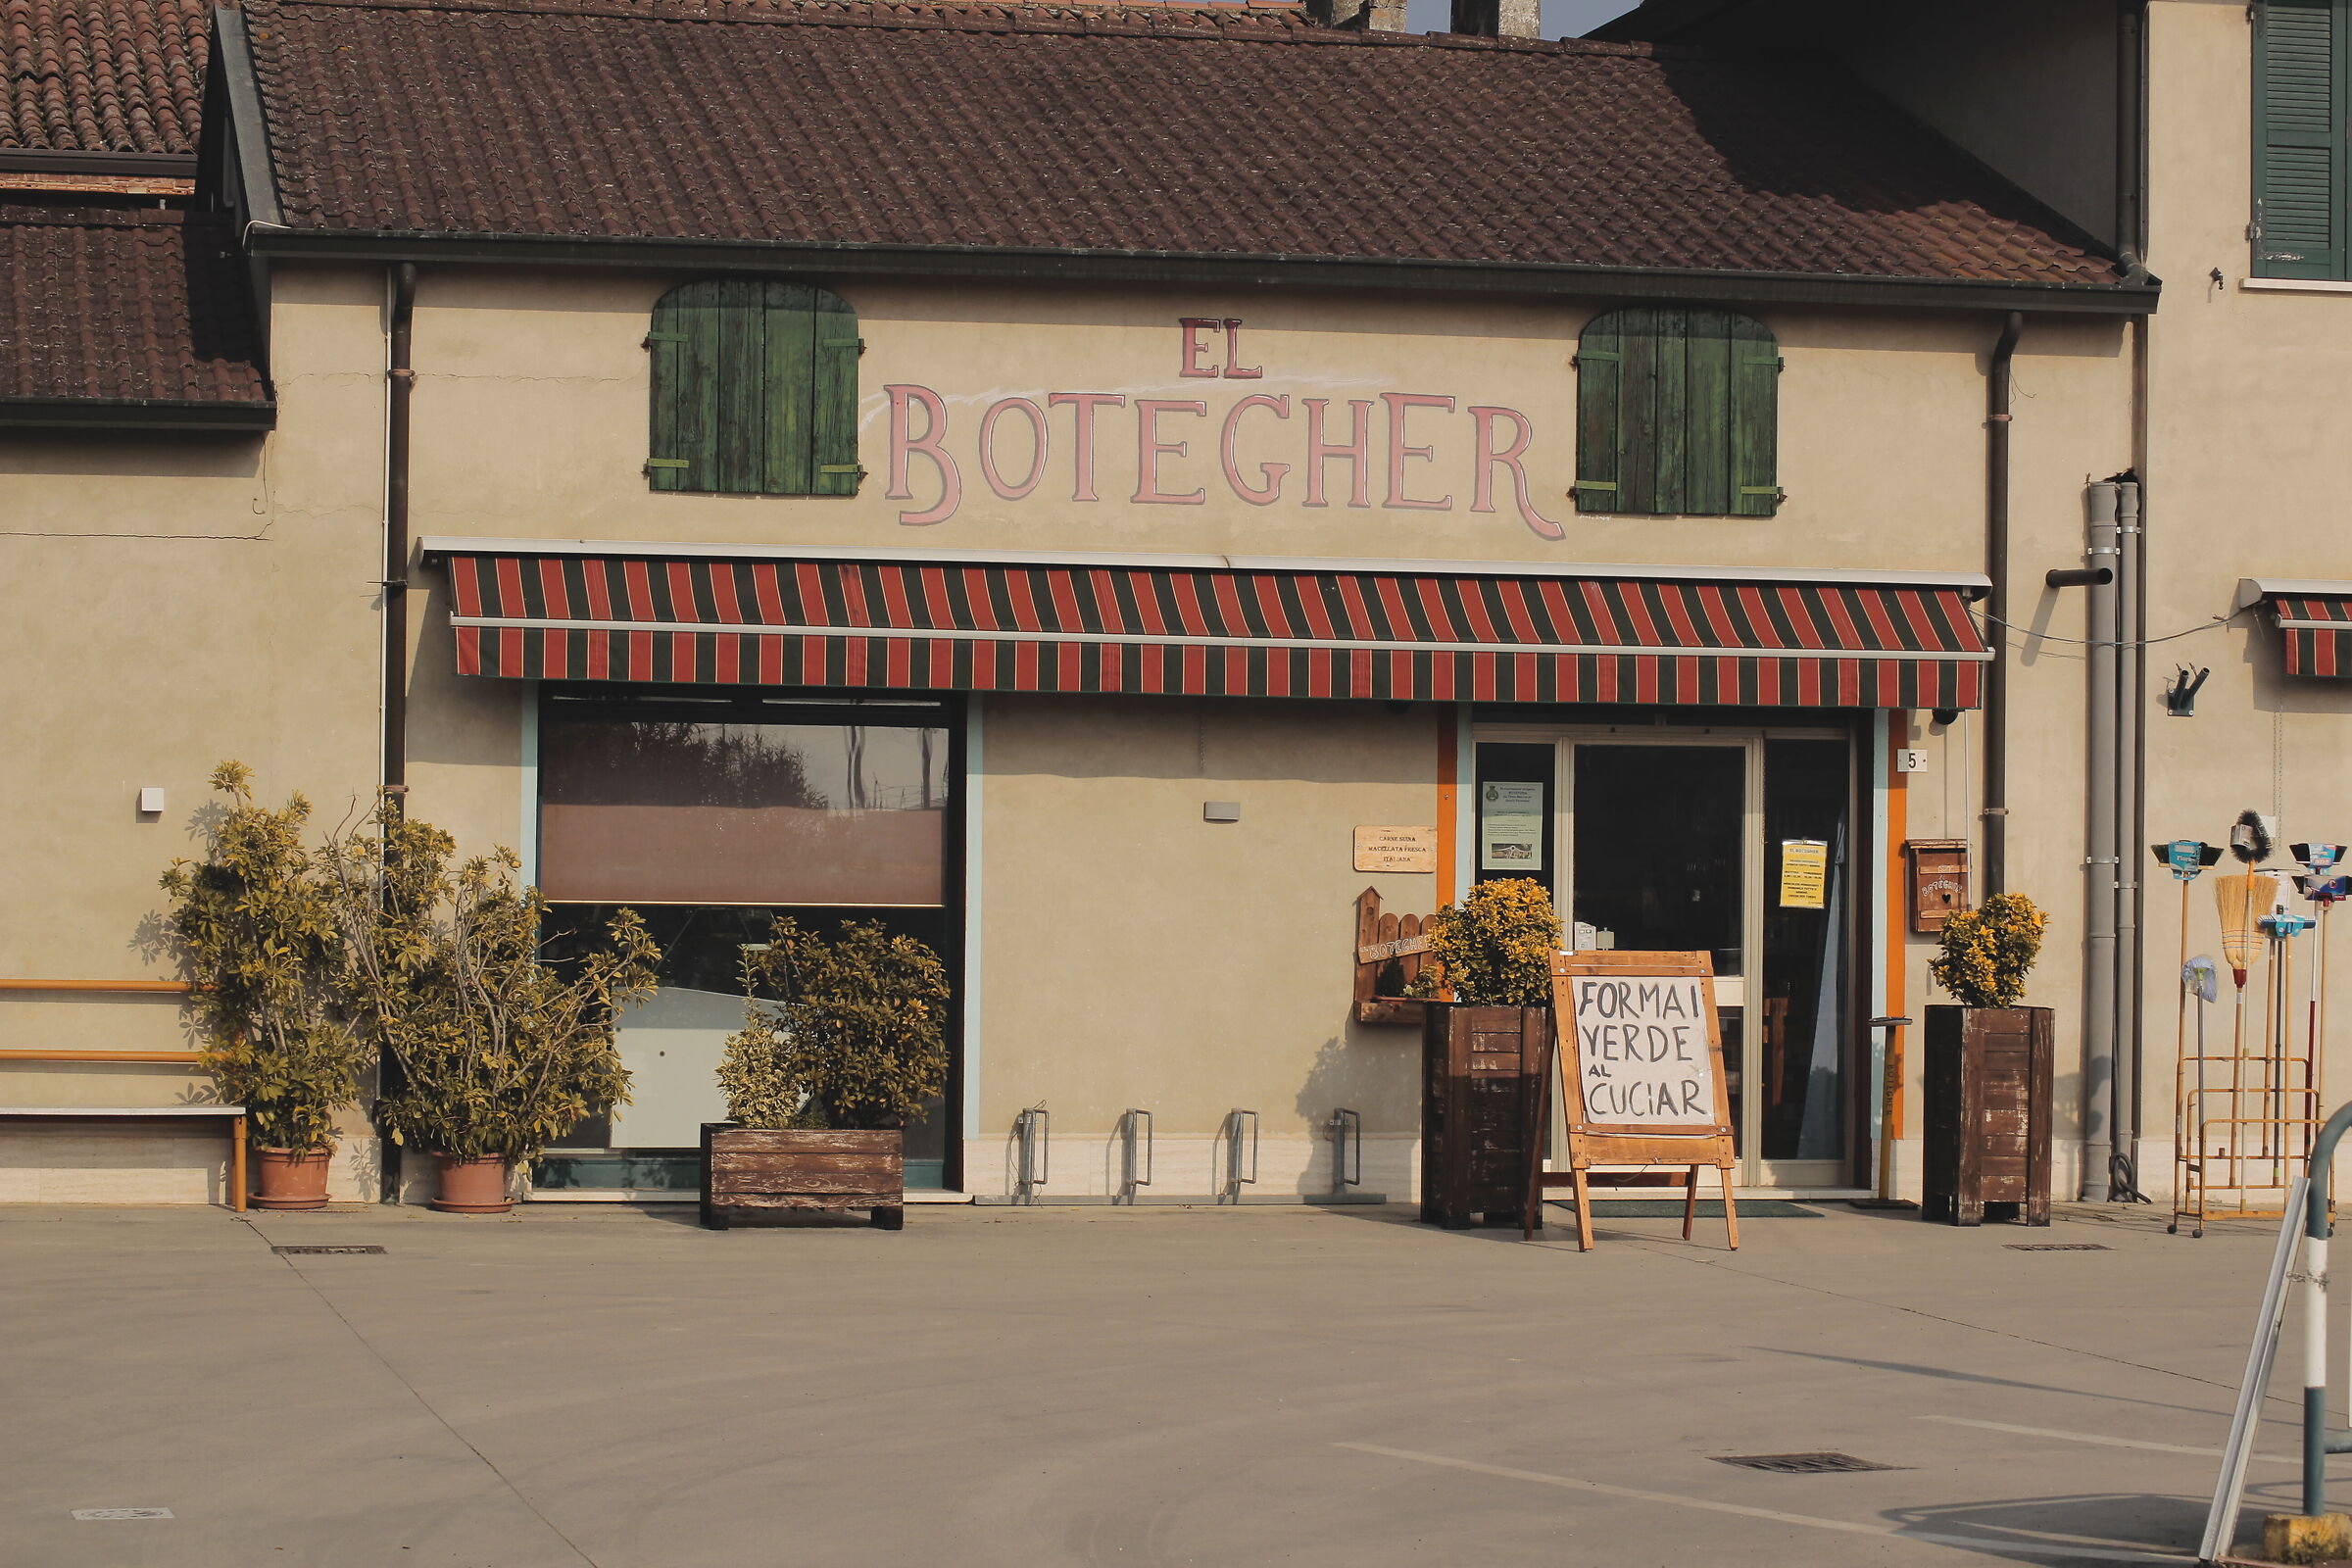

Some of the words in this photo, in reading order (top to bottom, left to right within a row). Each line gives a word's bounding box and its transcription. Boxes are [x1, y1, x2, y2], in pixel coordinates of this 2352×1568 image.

[1178, 318, 1263, 379] EL
[883, 383, 1567, 542] BOTEGHER
[1908, 752, 1917, 769] 5
[1578, 981, 1699, 1020] FORMAI
[1581, 1024, 1693, 1062] VERDE
[1589, 1064, 1612, 1078] AL
[1589, 1079, 1708, 1117] CUCIAR
